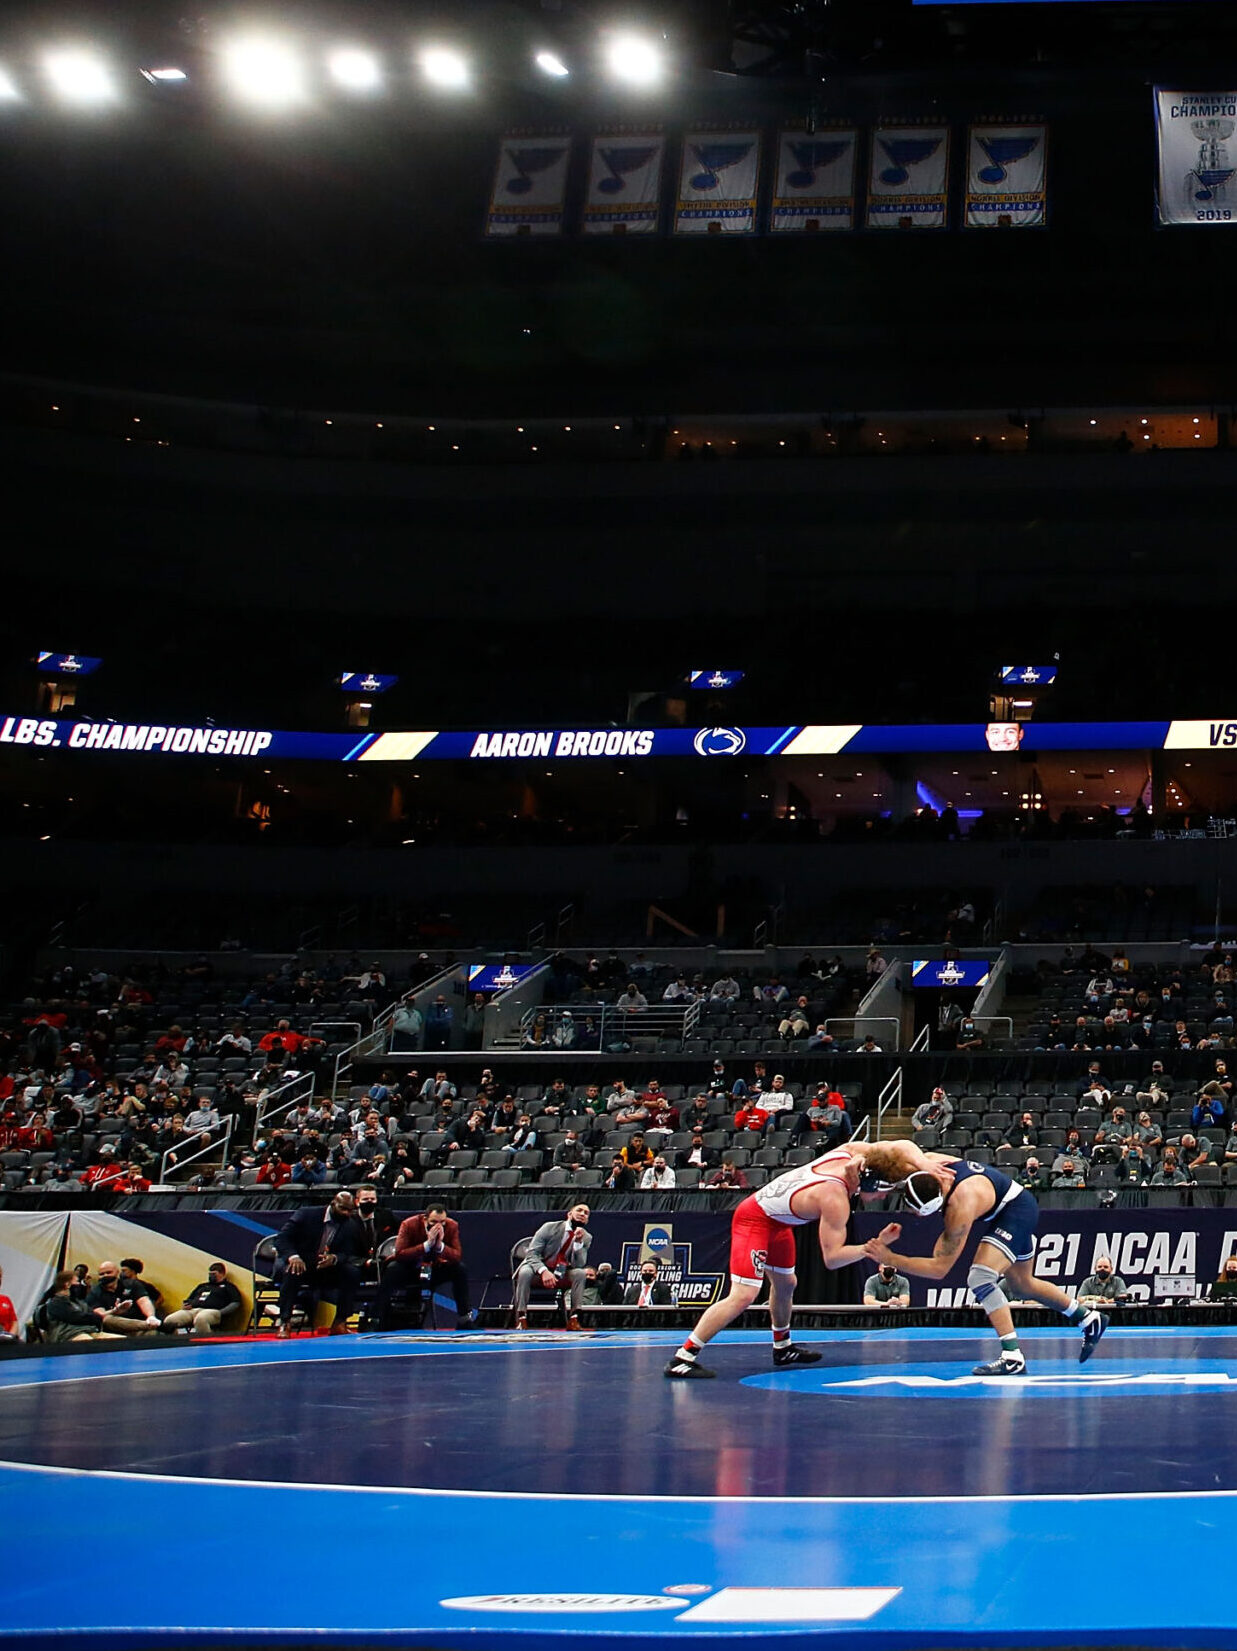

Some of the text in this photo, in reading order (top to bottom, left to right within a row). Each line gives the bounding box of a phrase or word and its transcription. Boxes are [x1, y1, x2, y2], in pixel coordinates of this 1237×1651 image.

[1182, 96, 1222, 105] STANLEY
[871, 204, 943, 212] CHAMPIONS
[971, 202, 1041, 211] CHAMPIONS
[681, 208, 751, 218] CHAMPIONS
[1197, 210, 1231, 221] 2019
[0, 717, 273, 756] LBS. CHAMPIONSHIP
[470, 731, 654, 758] AARON BROOKS
[647, 1238, 669, 1246] NCAA
[1030, 1233, 1081, 1277] 21
[1090, 1231, 1197, 1276] NCAA
